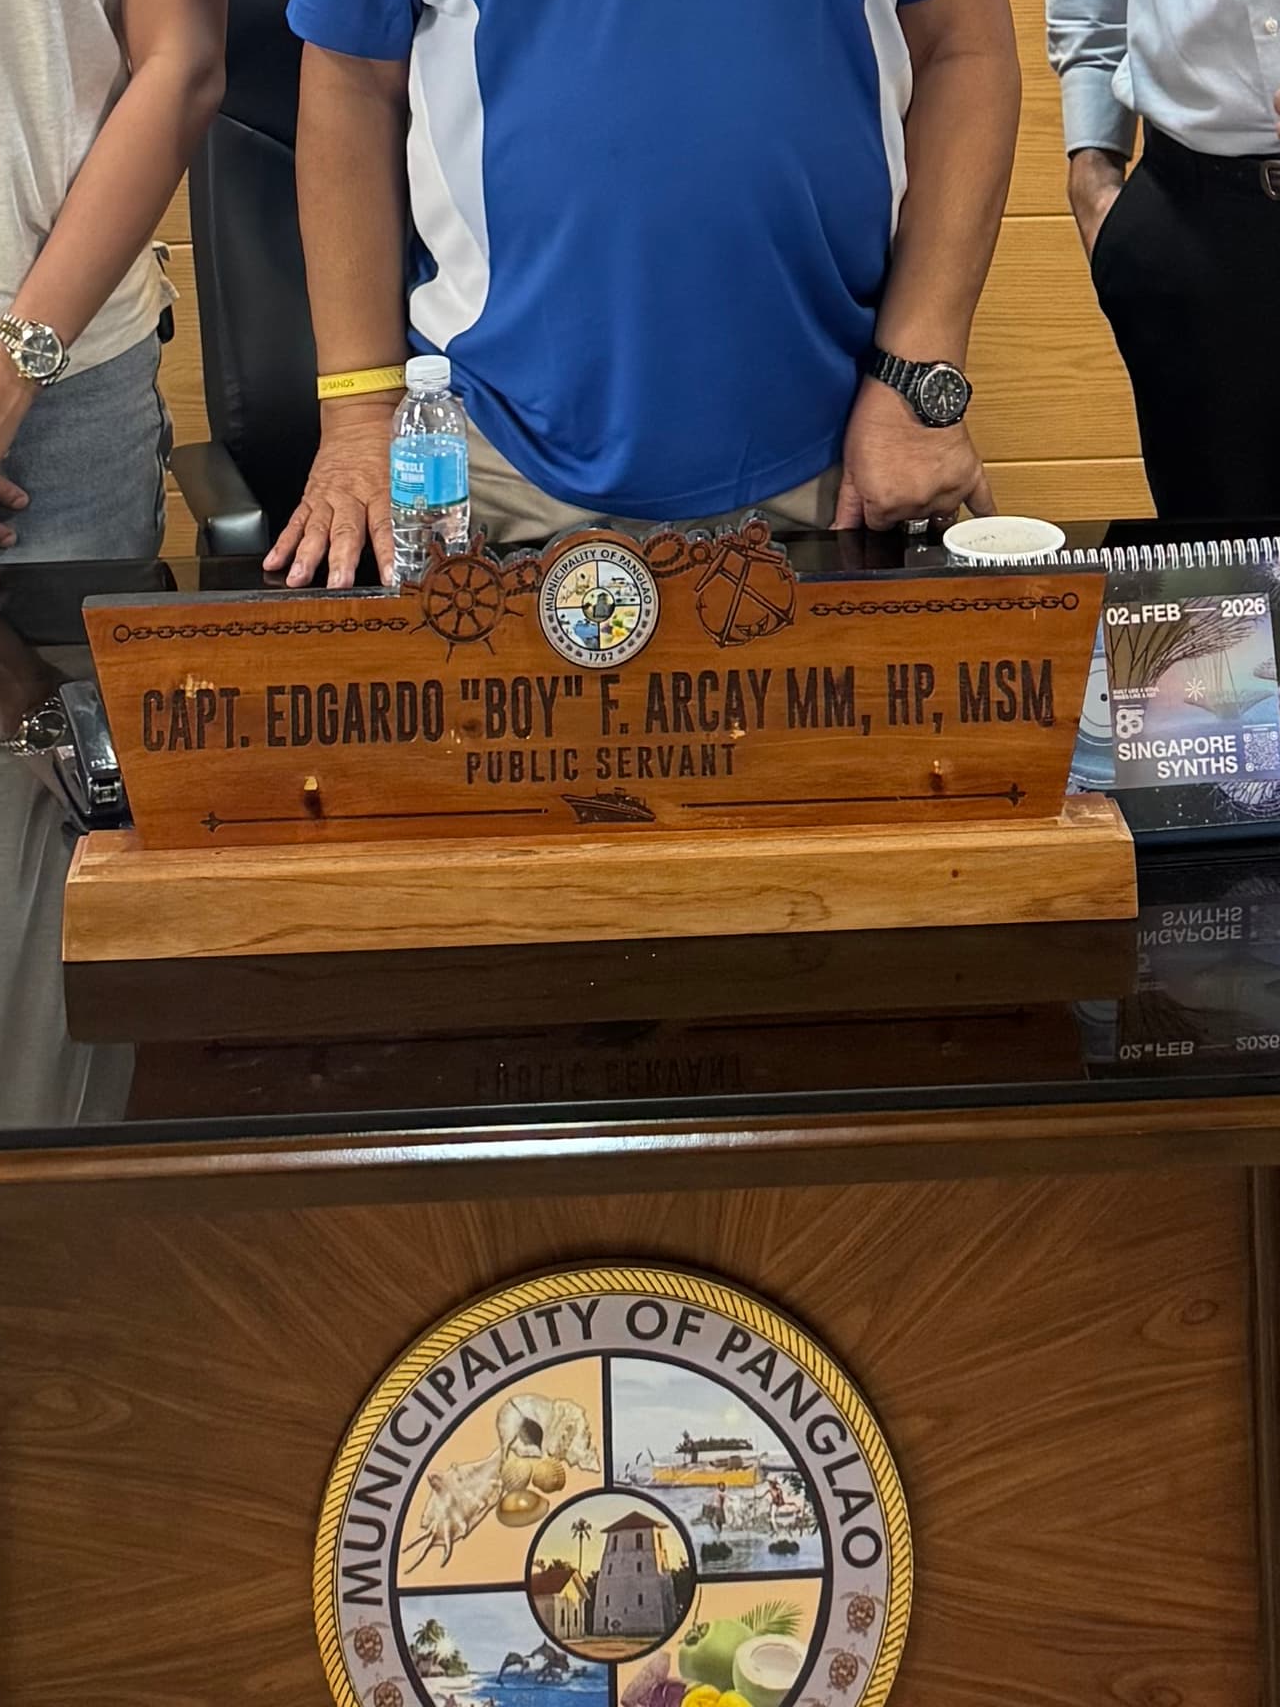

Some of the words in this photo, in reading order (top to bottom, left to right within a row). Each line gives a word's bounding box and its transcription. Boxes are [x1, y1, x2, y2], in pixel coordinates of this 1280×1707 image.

[545, 549, 597, 612] MUNICIPALITY
[600, 549, 617, 560] OF
[619, 555, 652, 605] PANGLAO
[1221, 598, 1266, 618] 2026
[143, 687, 250, 752] CAPT.
[266, 680, 444, 748] EDGARDO
[460, 675, 583, 740] "BOY"
[600, 674, 629, 736] F.
[644, 668, 773, 734] ARCAY
[786, 665, 872, 736] MM,
[887, 663, 943, 734] HP,
[958, 659, 1055, 727] MSM
[466, 747, 579, 784] PUBLIC
[595, 742, 737, 781] SERVANT
[1118, 735, 1237, 761] SINGAPORE
[1157, 756, 1238, 779] SYNTHS
[342, 1298, 601, 1606] MUNICIPALITY
[625, 1299, 707, 1346] OF
[715, 1324, 883, 1569] PANGLAO
